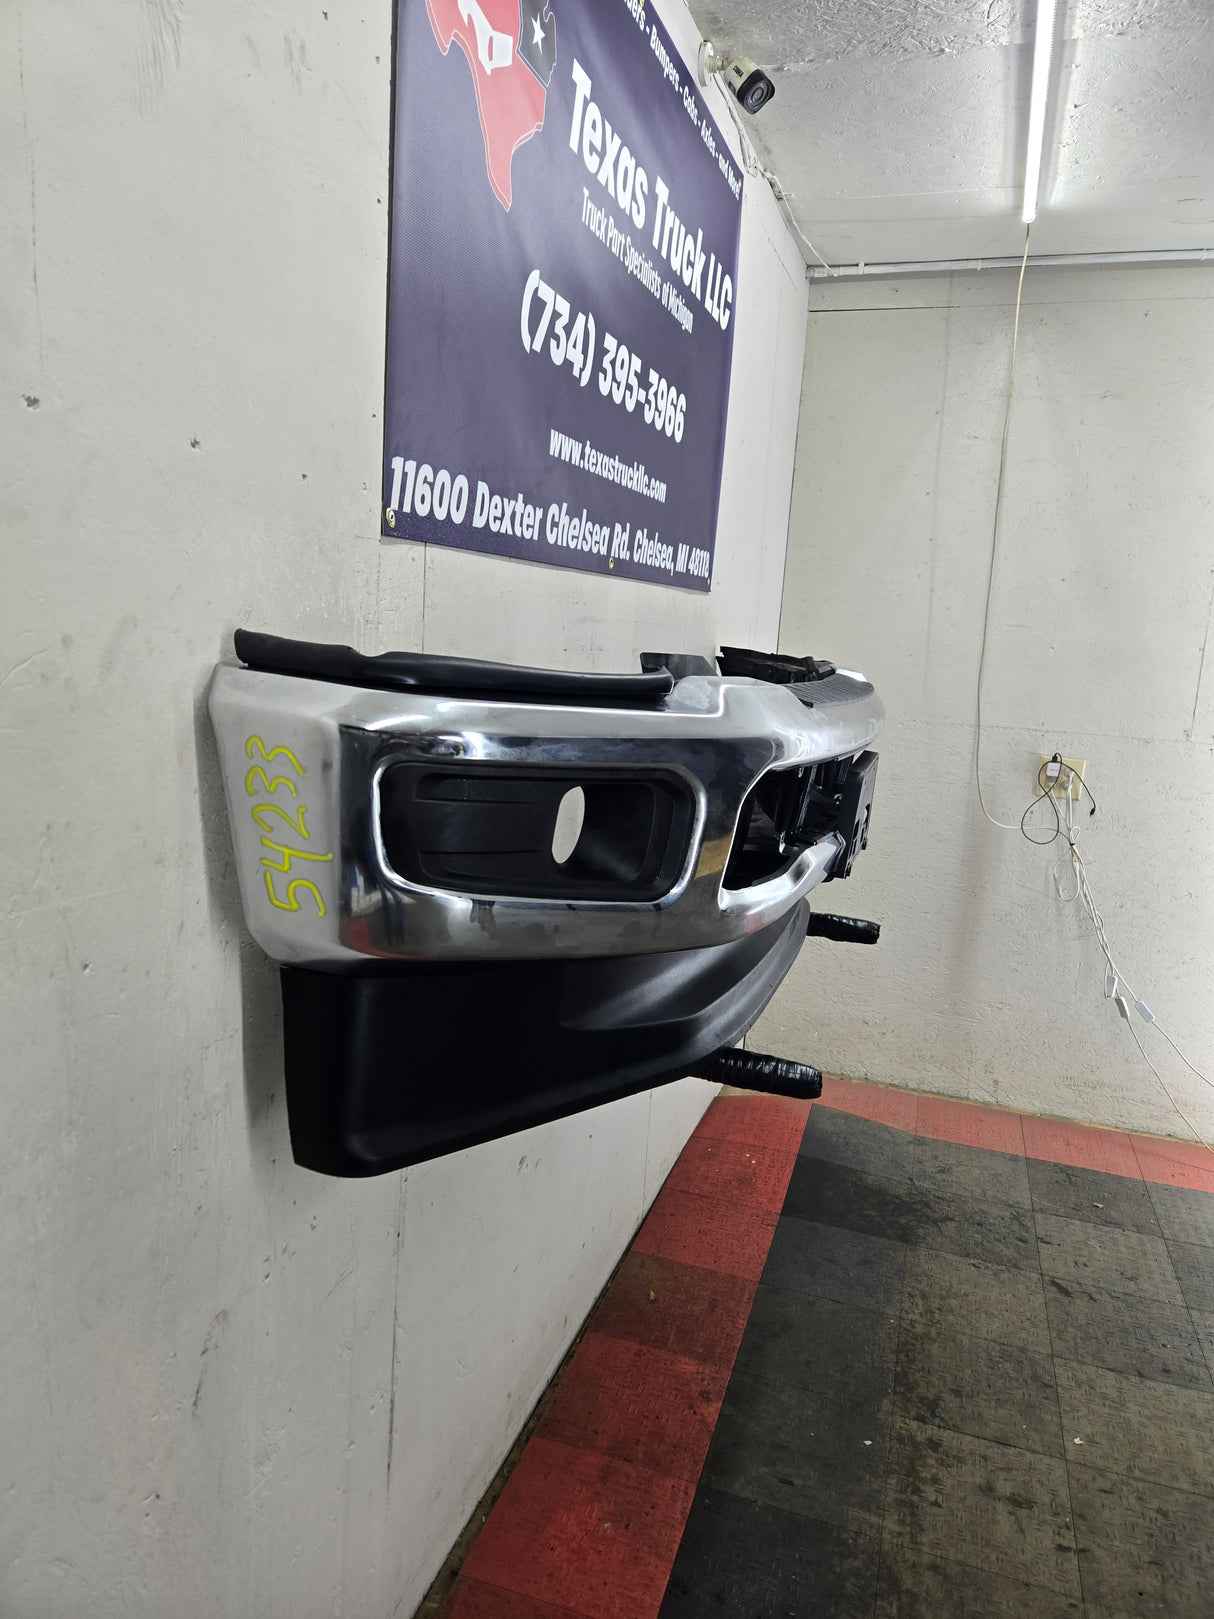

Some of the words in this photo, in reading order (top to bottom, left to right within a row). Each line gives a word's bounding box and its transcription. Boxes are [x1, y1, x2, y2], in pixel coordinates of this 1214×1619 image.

[649, 24, 680, 92] Bumpers
[683, 85, 698, 126] Cabs
[718, 153, 729, 180] and
[569, 58, 648, 229] Texas
[652, 175, 707, 301] Truck
[704, 252, 733, 331] LLC
[582, 186, 608, 244] Truck
[606, 215, 626, 262] Part
[624, 235, 661, 300] Specialists
[661, 281, 671, 308] of
[667, 284, 694, 334] Michigan
[520, 269, 596, 387] (734)
[598, 331, 687, 443] 395-3966
[391, 456, 468, 525] 11600
[472, 480, 543, 541] Dexter
[545, 502, 611, 556] Chelsea
[610, 522, 631, 561] Rd.
[633, 528, 674, 577] Chelsea,
[675, 542, 690, 574] MI
[687, 546, 711, 579] 48118
[549, 428, 667, 504] www.texastruckllc.com
[244, 734, 334, 918] 54233
